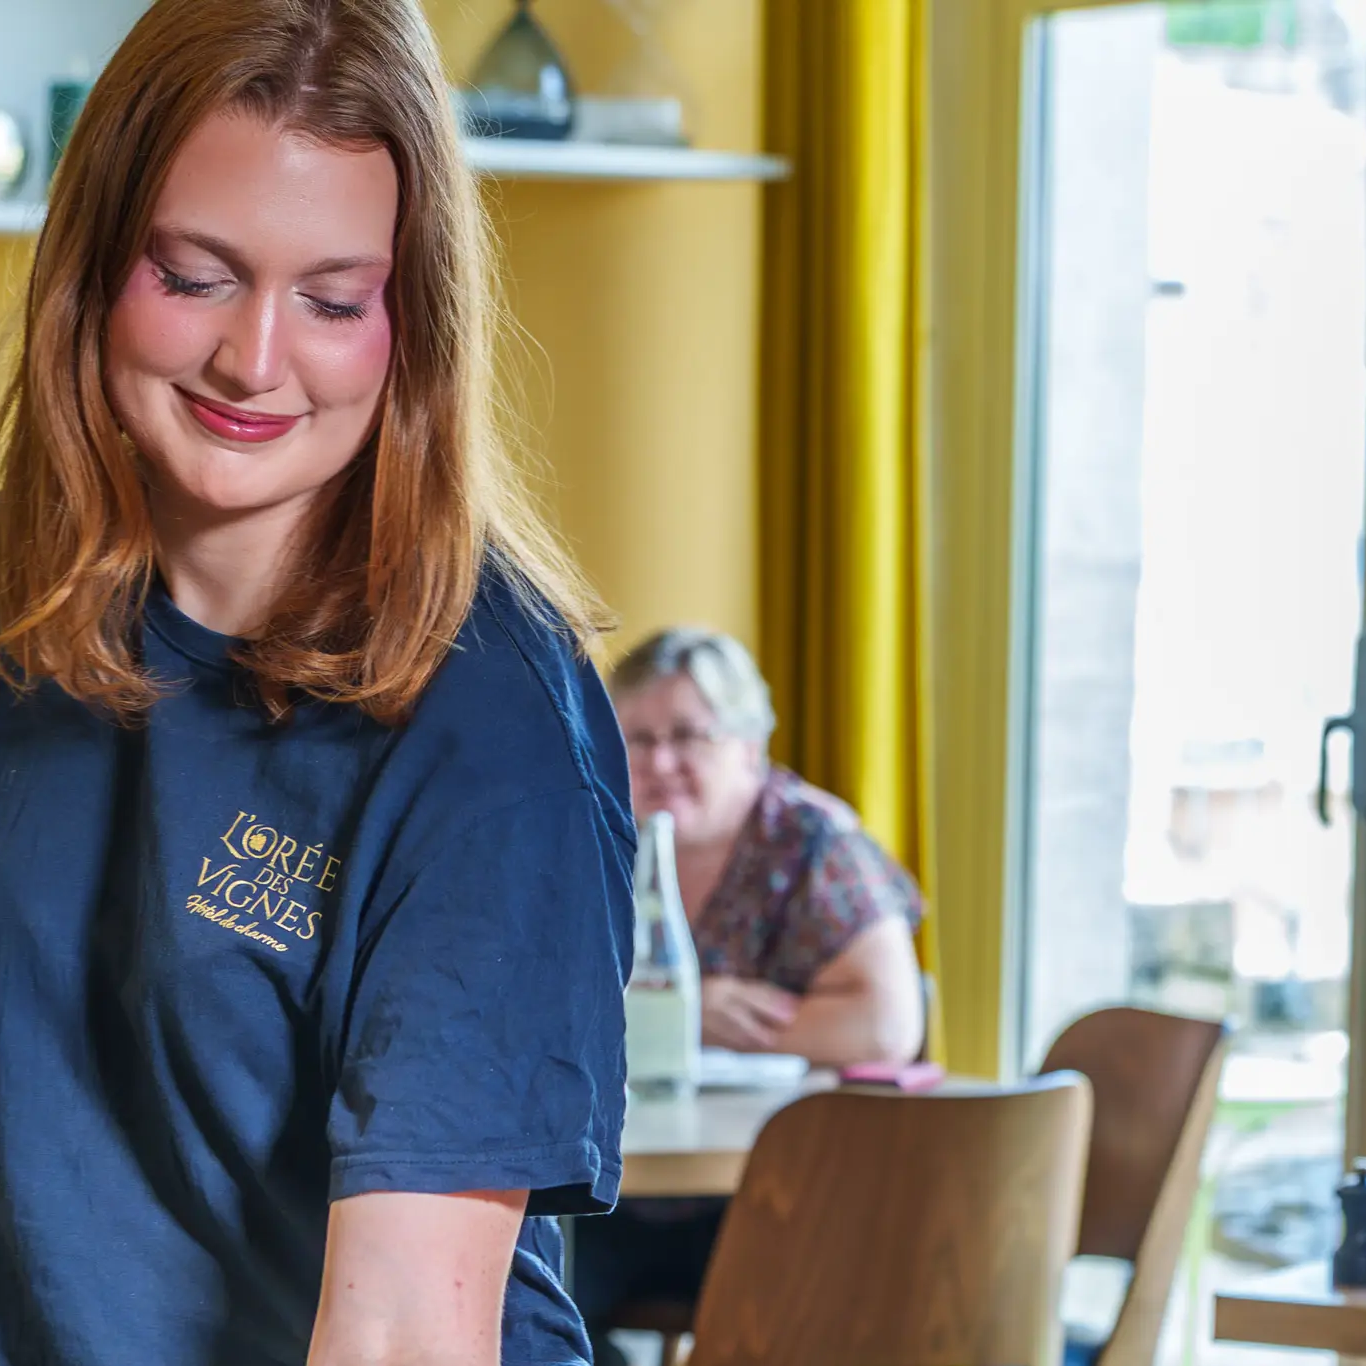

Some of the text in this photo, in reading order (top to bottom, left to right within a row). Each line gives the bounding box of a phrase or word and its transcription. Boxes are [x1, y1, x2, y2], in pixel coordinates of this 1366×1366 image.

[220, 811, 341, 892] L'ORÉE
[253, 867, 295, 895] DES
[197, 857, 323, 940] VIGNES
[219, 914, 240, 929] de
[234, 921, 289, 952] charme
